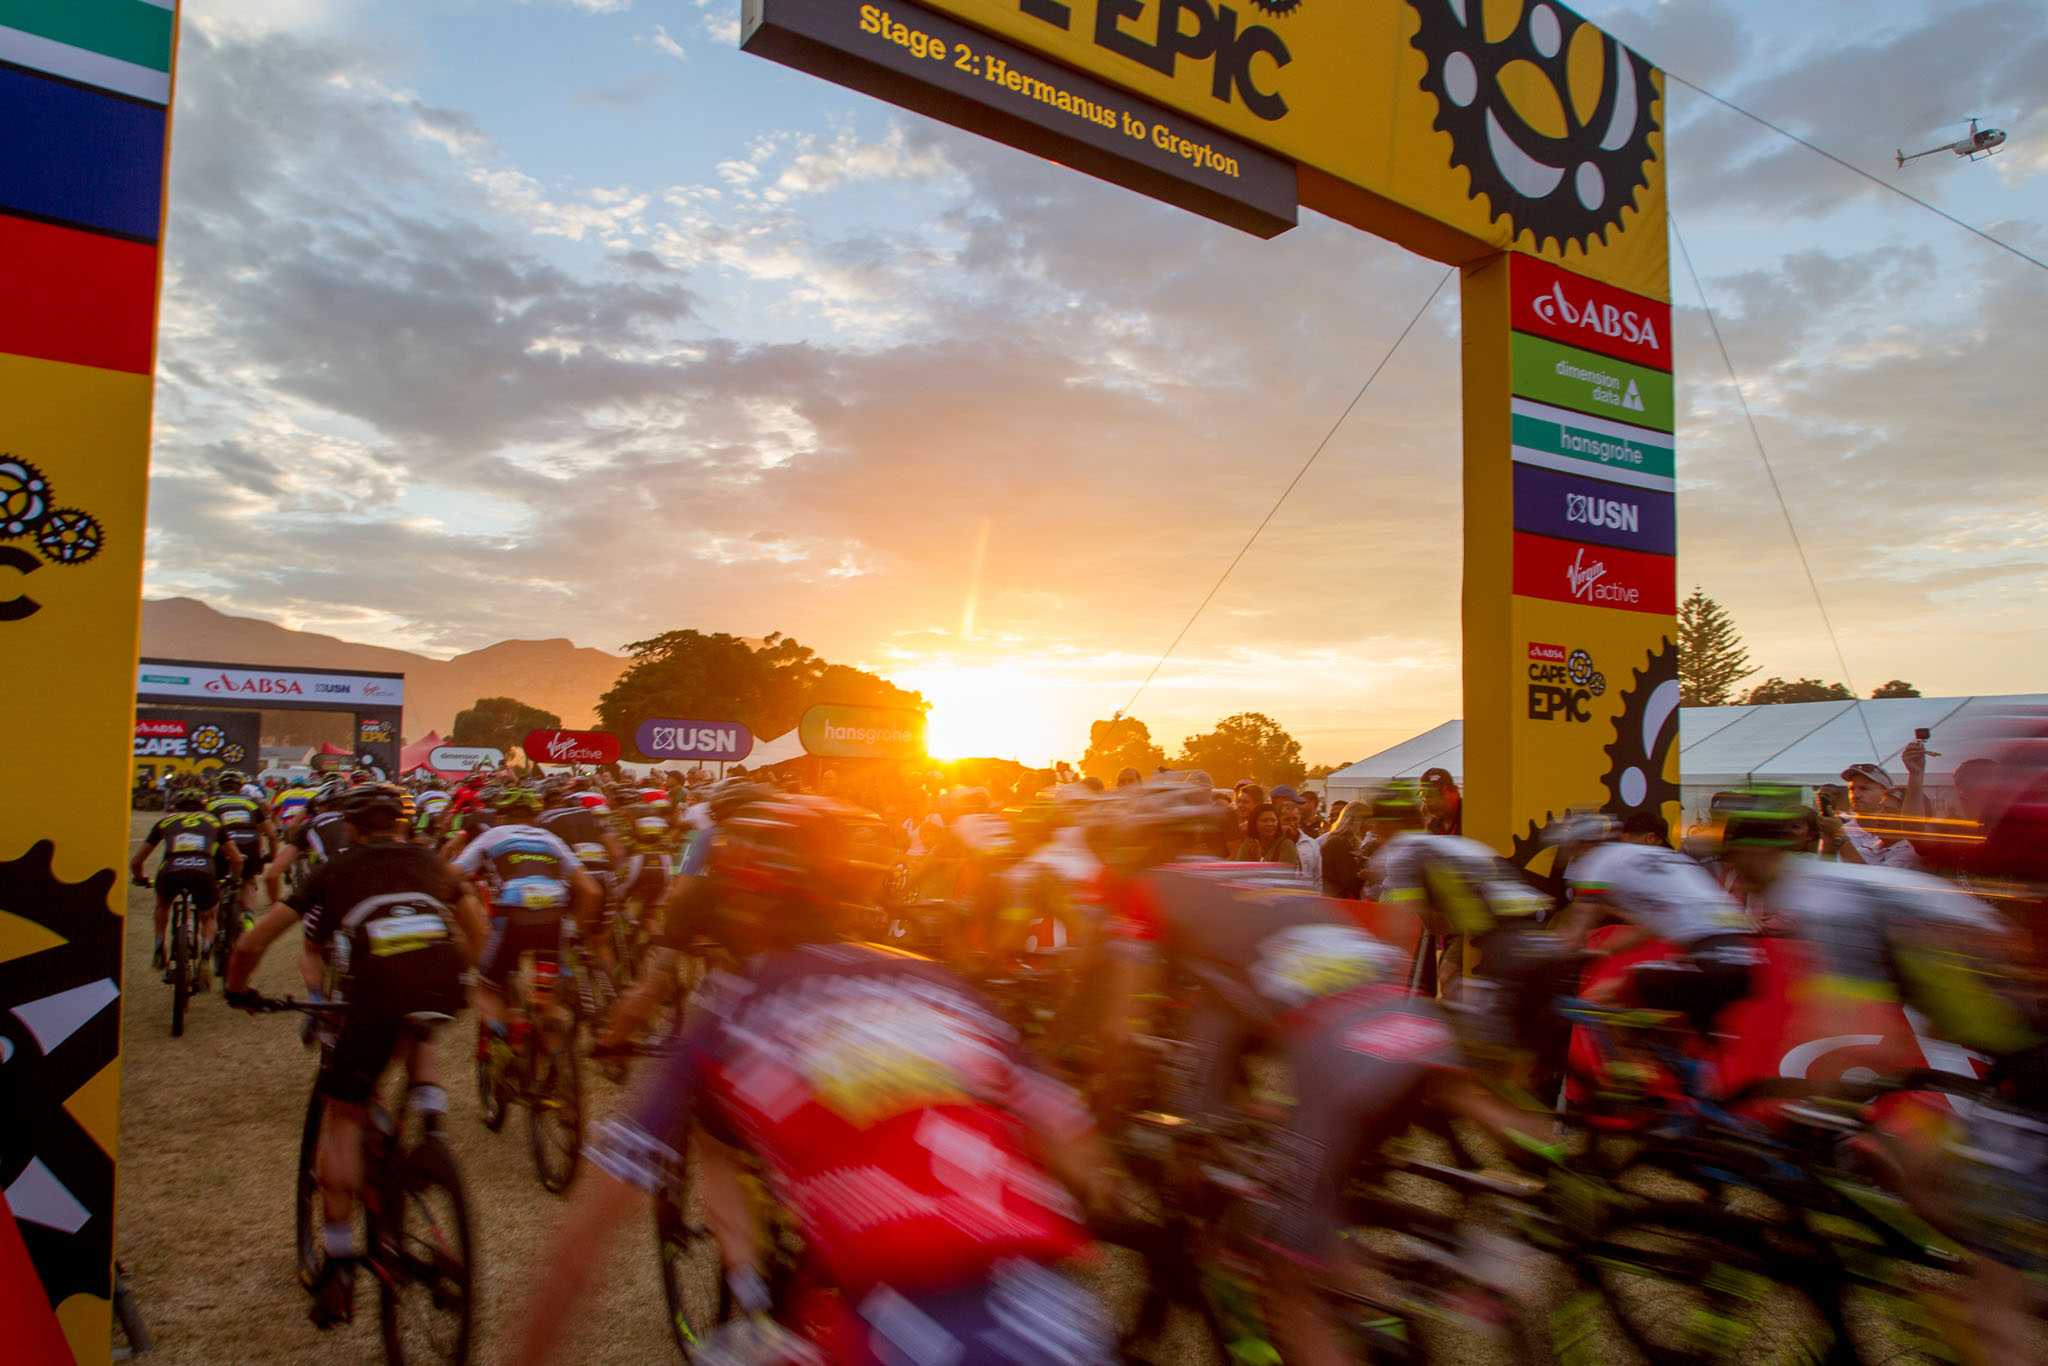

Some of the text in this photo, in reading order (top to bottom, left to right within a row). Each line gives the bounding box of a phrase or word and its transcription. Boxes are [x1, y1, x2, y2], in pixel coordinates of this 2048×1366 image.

[1094, 0, 1293, 121] EPIC
[859, 4, 1240, 178] Stage 2: Hermanus to Greyton
[1579, 298, 1660, 350] ABSA
[1555, 360, 1620, 389] dimension
[1592, 386, 1620, 406] data
[1560, 425, 1643, 464] hansgrohe
[1587, 497, 1639, 532] USN
[1566, 548, 1607, 601] Virgin
[1595, 582, 1639, 603] active
[241, 678, 303, 695] ABSA
[1528, 663, 1567, 684] CAPE
[1528, 684, 1592, 723] EPIC
[677, 727, 736, 752] USN
[825, 719, 912, 744] hansgrohe
[547, 732, 577, 760] Virgin
[567, 748, 603, 760] active
